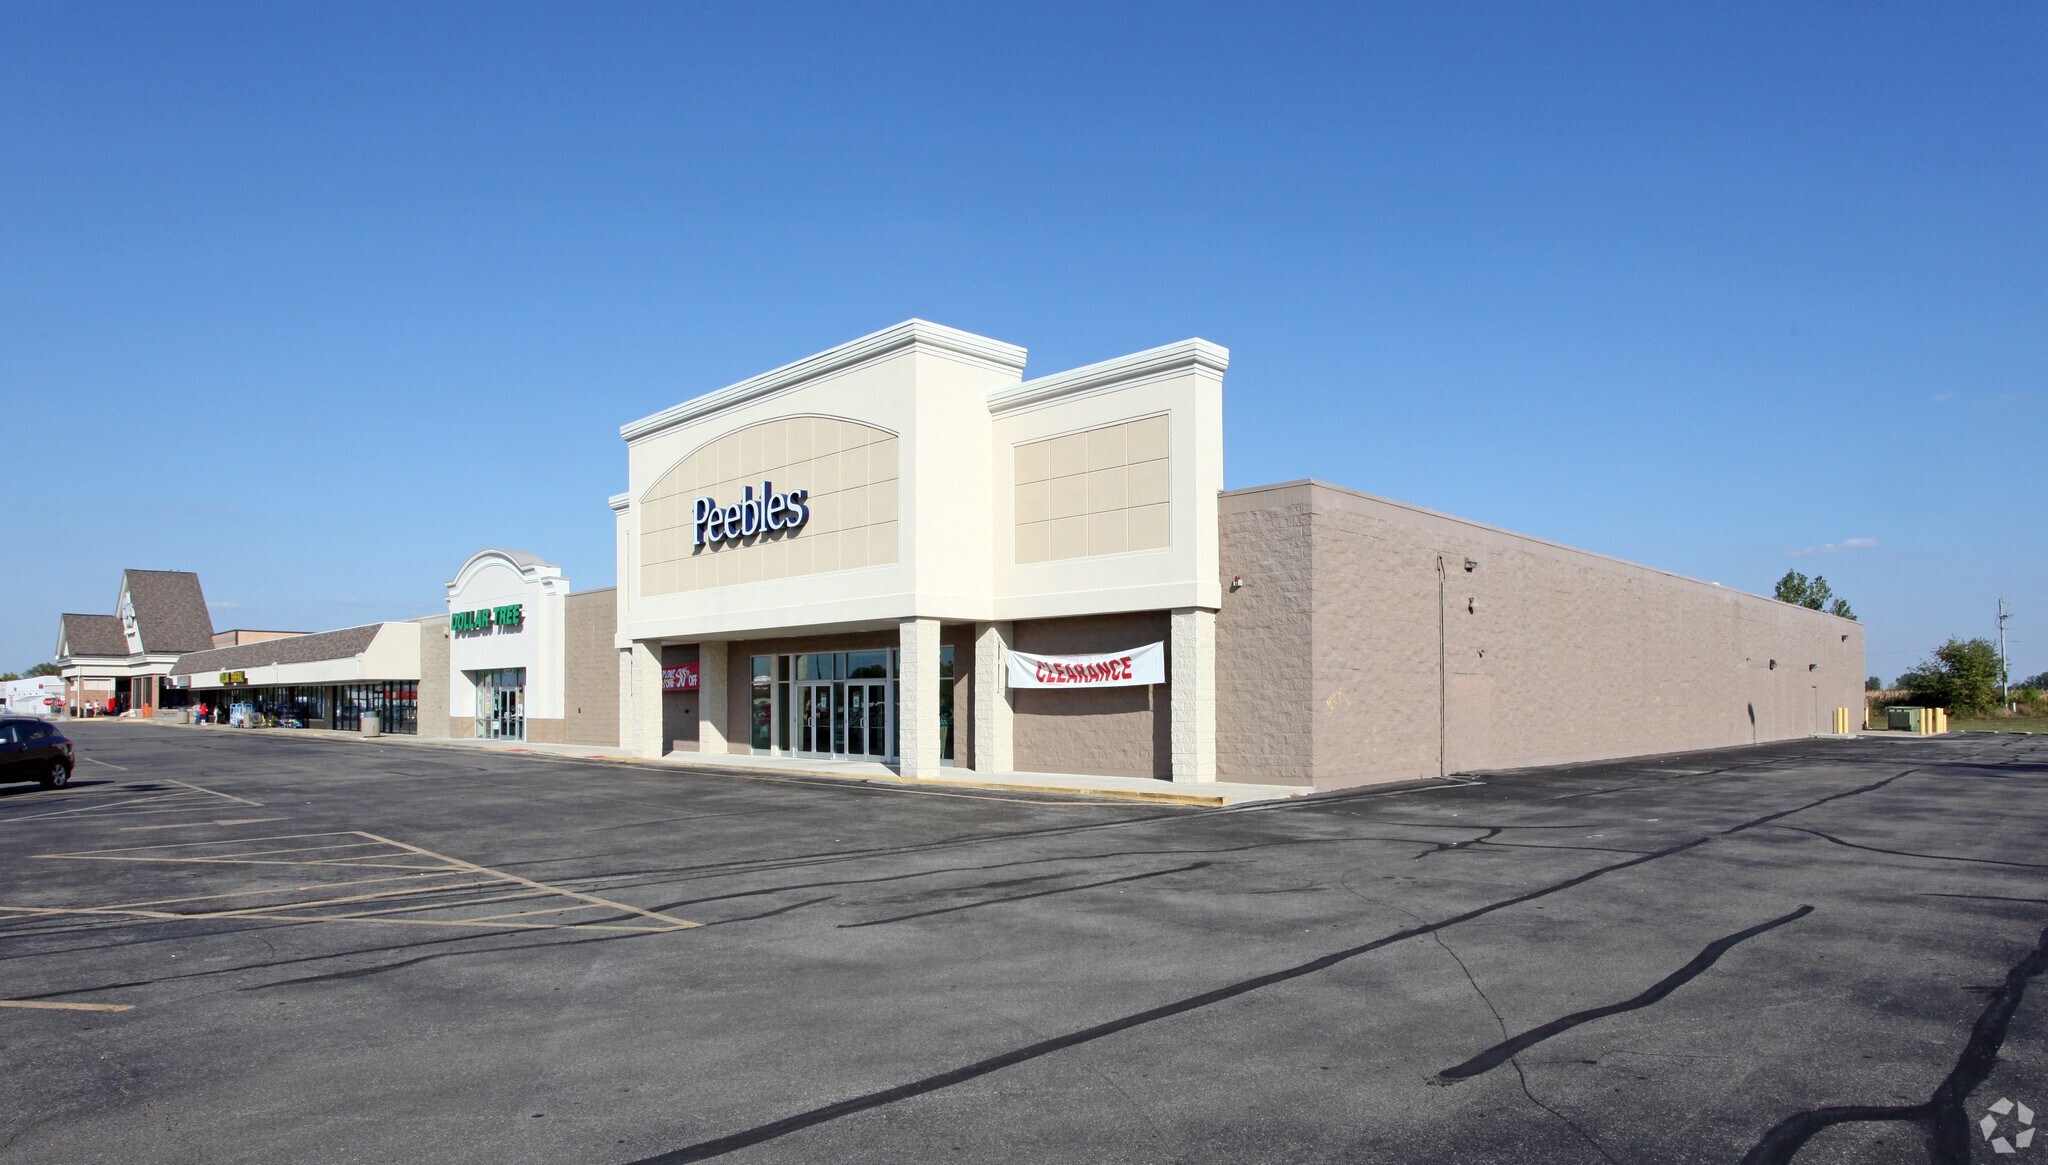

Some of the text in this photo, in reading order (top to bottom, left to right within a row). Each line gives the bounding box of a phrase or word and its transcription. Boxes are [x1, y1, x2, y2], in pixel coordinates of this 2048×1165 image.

[692, 480, 809, 546] Peebles
[451, 604, 522, 631] DOLLAR TREE
[688, 674, 698, 687] OFF
[1036, 656, 1132, 683] CLEARANCE
